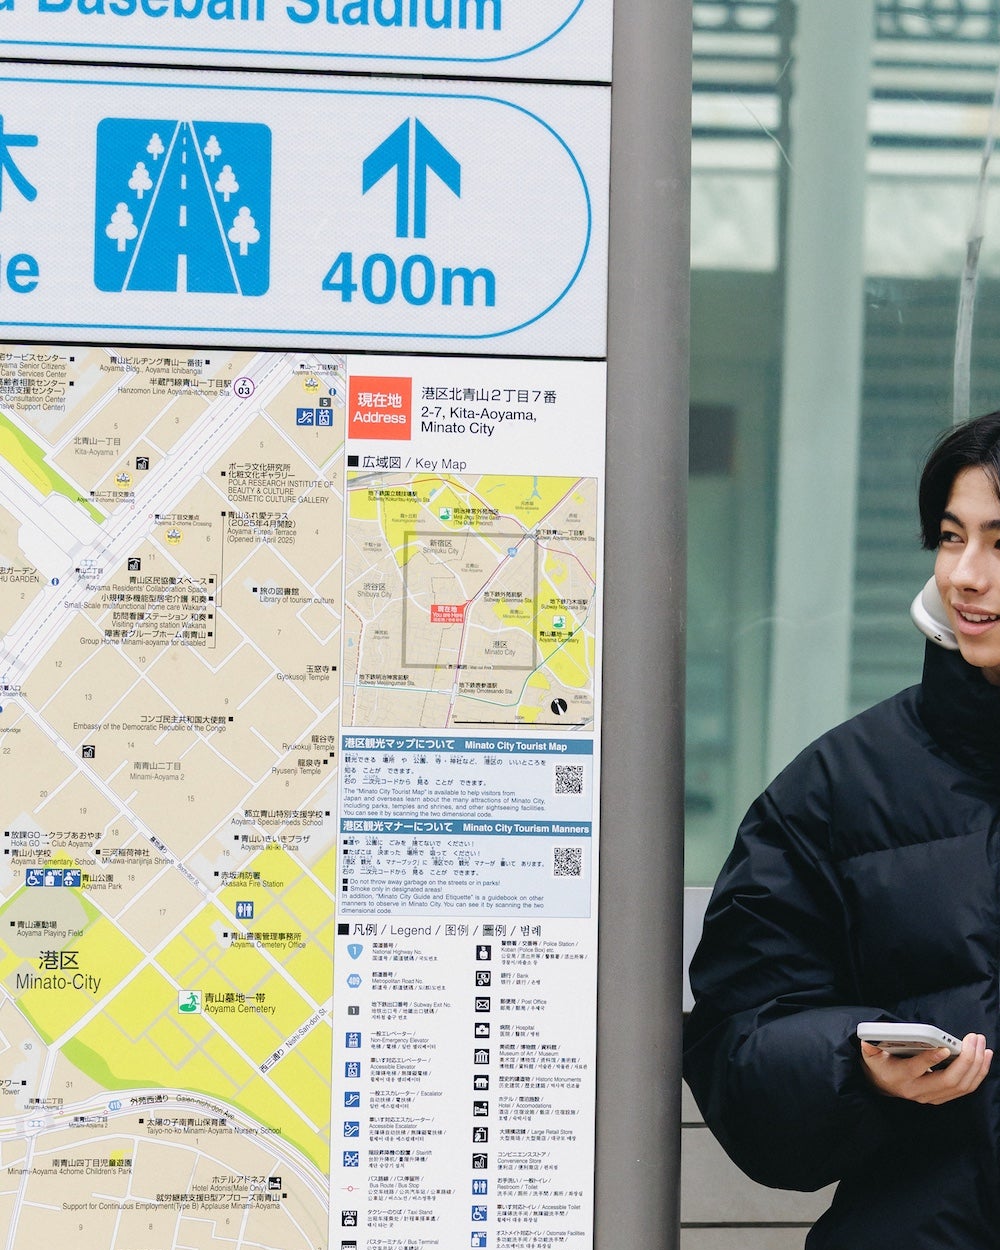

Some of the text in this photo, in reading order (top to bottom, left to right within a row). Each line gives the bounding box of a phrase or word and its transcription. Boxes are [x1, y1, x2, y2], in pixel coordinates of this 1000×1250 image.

[0, 252, 40, 294] e
[322, 251, 496, 307] 400m
[100, 365, 124, 373] Aoyama
[144, 366, 170, 374] Aoyama
[171, 366, 202, 375] Ichibangai
[238, 387, 250, 395] 03
[422, 387, 556, 405] 港区北青山2丁目7番
[358, 393, 402, 409] 現在地
[353, 411, 406, 424] Address
[421, 406, 537, 424] 2-7, Kita-Aoyama,
[421, 421, 494, 438] Minato City
[74, 437, 121, 447] 北青山一丁目
[74, 448, 113, 458] Kita-Aoyama
[363, 457, 401, 469] 広域図
[415, 458, 437, 470] Key
[442, 459, 466, 471] Map
[85, 584, 110, 593] Aoyama
[187, 586, 207, 594] Space
[260, 587, 299, 596] 旅の図書館
[260, 596, 280, 605] Library
[313, 597, 334, 605] culture
[80, 638, 99, 646] Group
[141, 715, 226, 725] コンゴ民主共和国大使館
[74, 723, 226, 734] Embassy of the Democratic Republic of the Congo
[345, 738, 455, 751] 港区観光マップについて
[465, 741, 567, 753] Minato City Tourist Map
[134, 762, 181, 771] 南青山二丁目
[130, 773, 179, 782] Minami-Aoyama
[244, 810, 323, 819] 都立青山特別支援学校
[231, 819, 323, 828] Aoyama Special-needs School
[343, 821, 452, 834] 港区観光マナーについて
[463, 823, 589, 834] Minato City Tourism Manners
[11, 849, 51, 857] 青山小学校
[11, 858, 36, 866] Aoyama
[221, 872, 260, 880] 赤坂消防署
[353, 924, 378, 936] 凡例
[390, 924, 431, 937] Legend
[445, 925, 469, 937] 图例
[520, 926, 542, 938] 범례
[39, 951, 80, 970] 港区
[16, 973, 101, 994] Minato-City
[205, 993, 266, 1003] 青山墓地一帯
[204, 1005, 275, 1015] Aoyama Cemetery
[147, 1118, 227, 1127] 太陽の子南青山保育園
[147, 1127, 181, 1136] Taiyo-no-ko
[183, 1128, 232, 1137] Minami-Aoyama
[234, 1128, 258, 1137] Nursery
